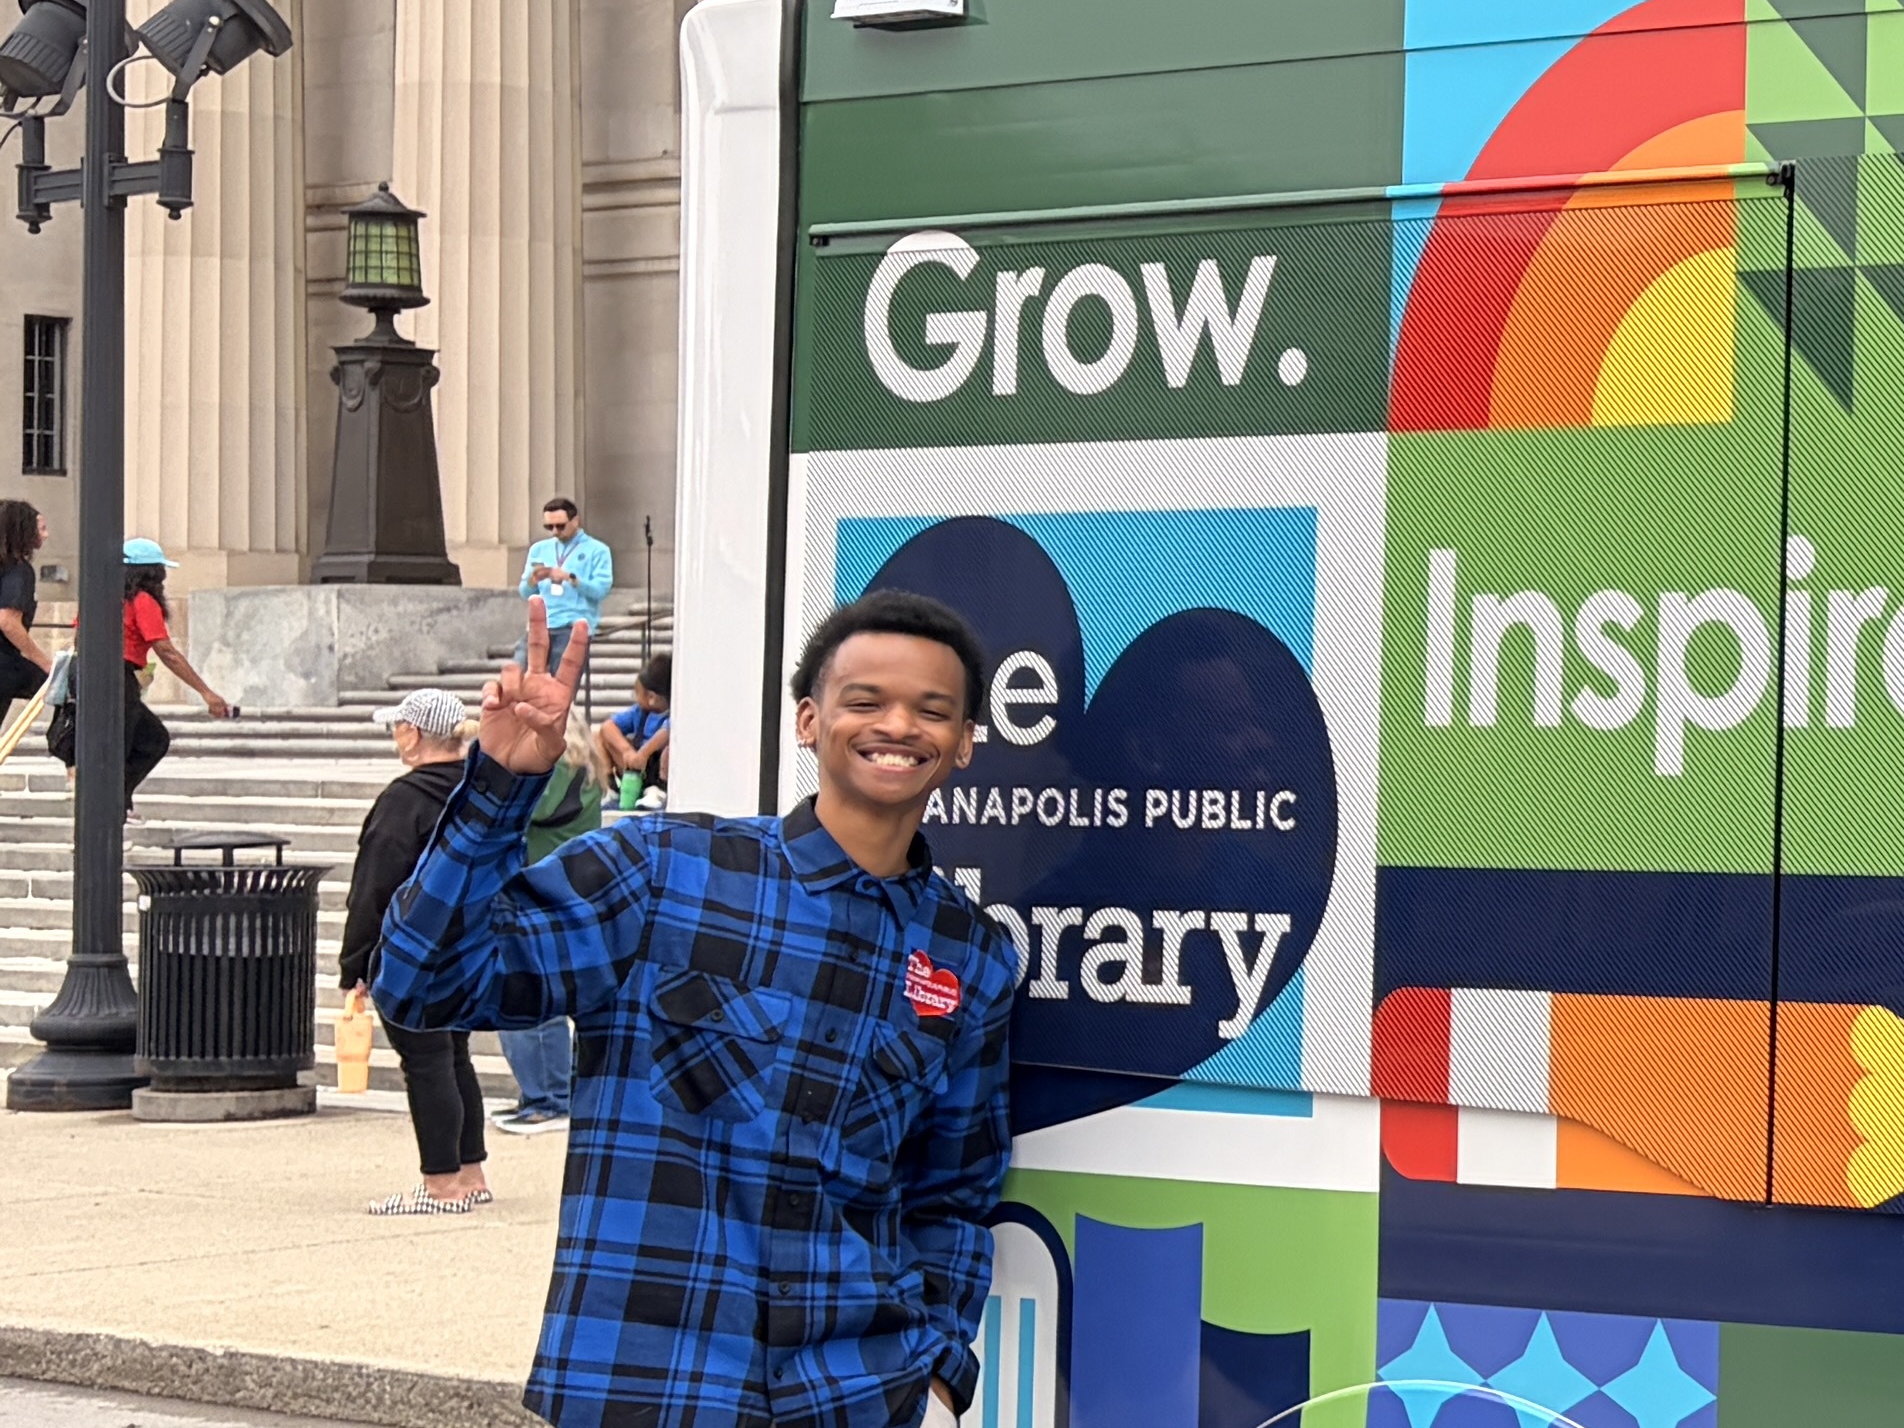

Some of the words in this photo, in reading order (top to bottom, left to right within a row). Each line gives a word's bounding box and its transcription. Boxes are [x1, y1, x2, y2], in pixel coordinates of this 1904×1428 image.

[864, 230, 1308, 403] Grow.
[922, 786, 1129, 828] ANAPOLIS
[1144, 788, 1298, 831] PUBLIC
[953, 866, 1291, 1039] brary
